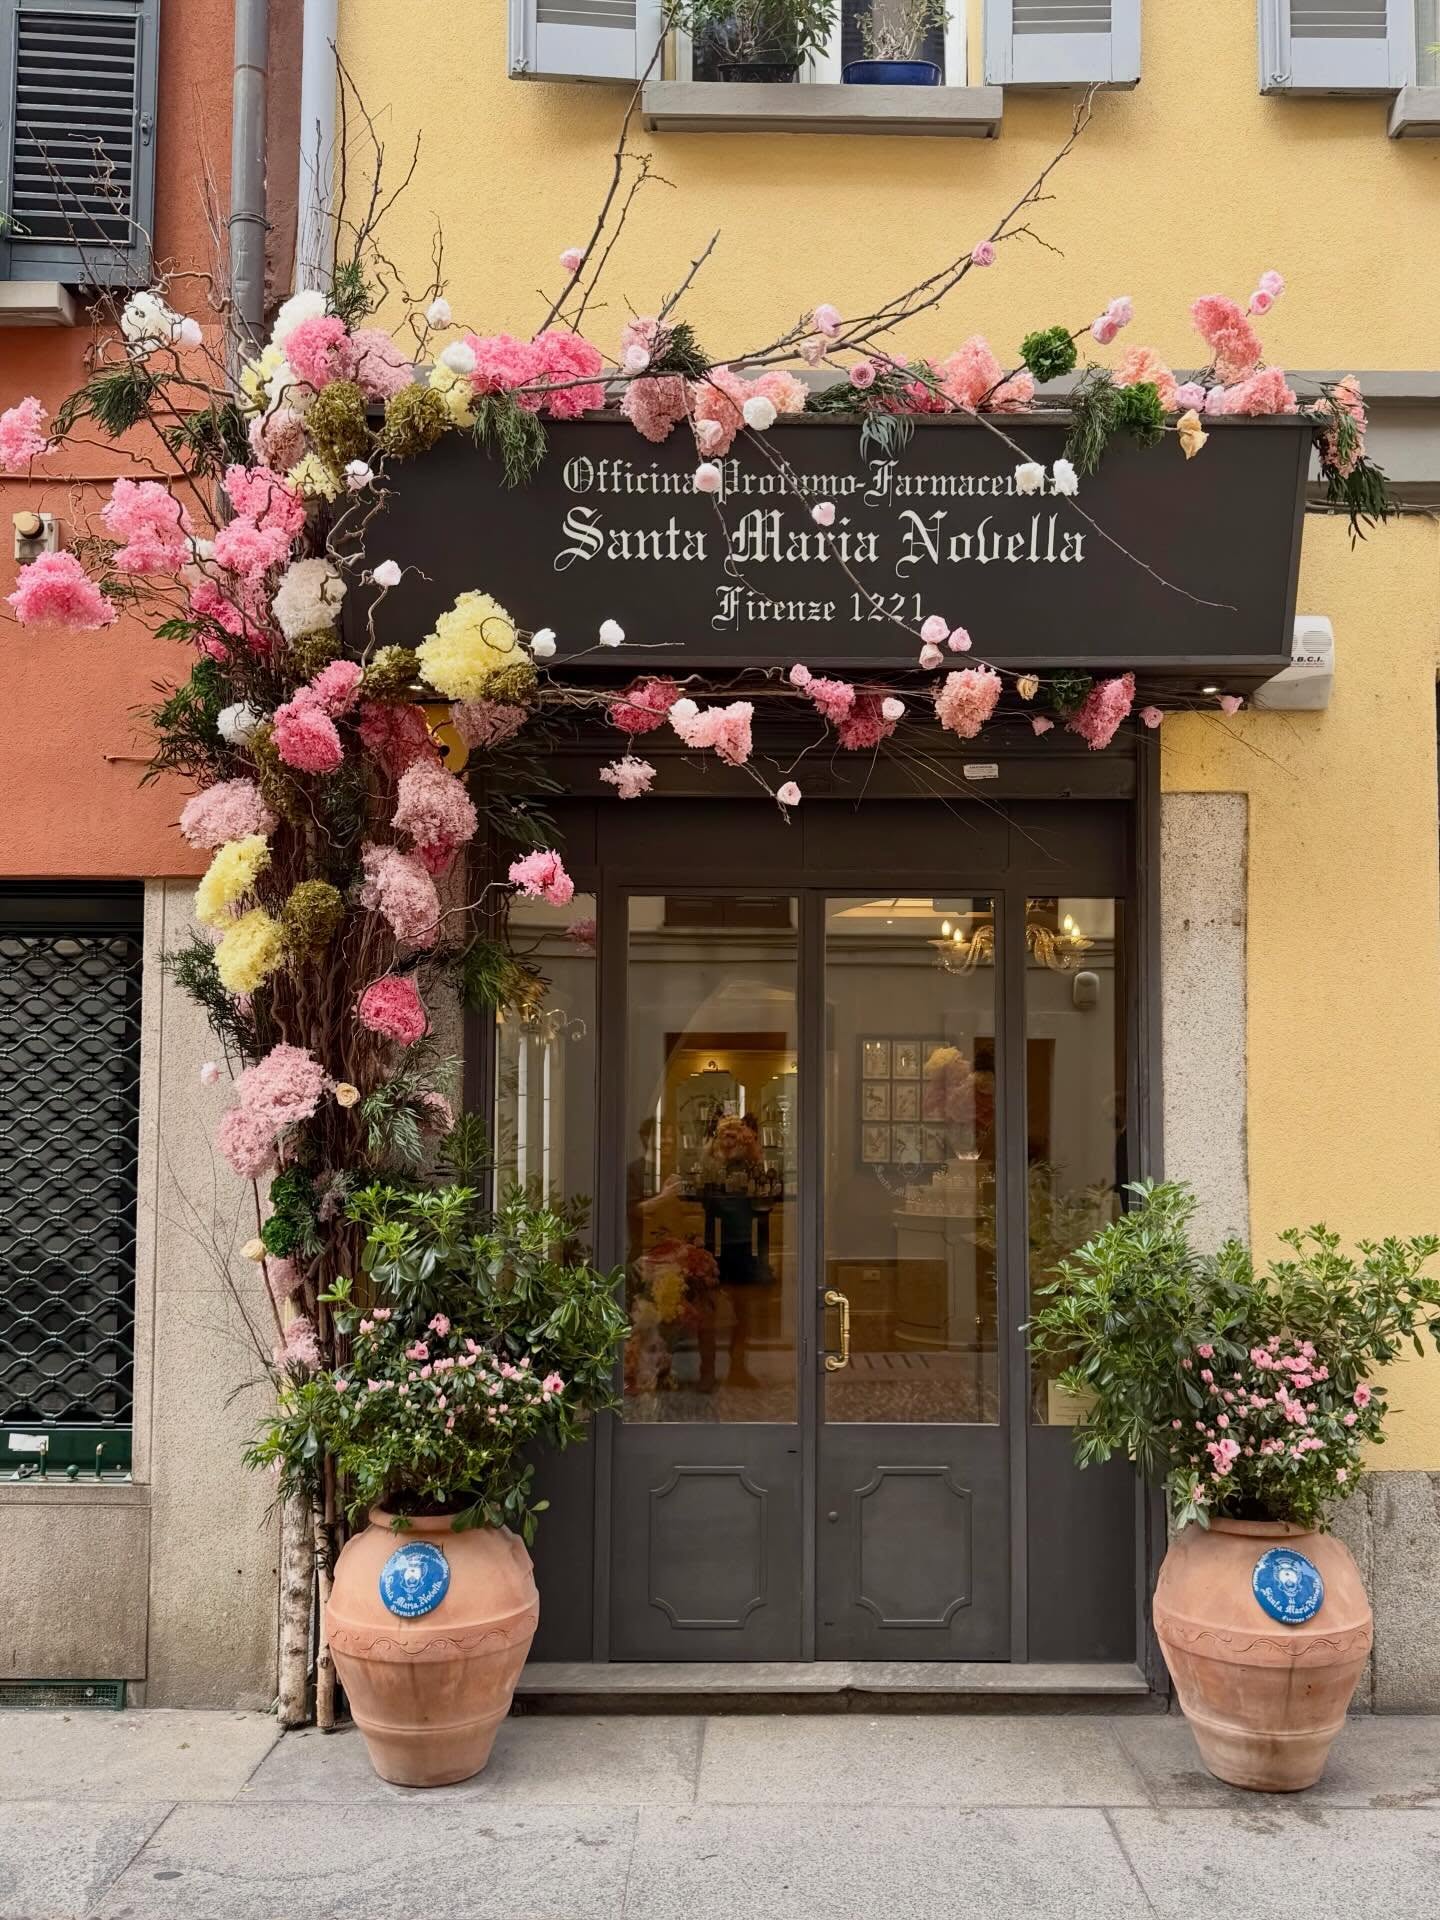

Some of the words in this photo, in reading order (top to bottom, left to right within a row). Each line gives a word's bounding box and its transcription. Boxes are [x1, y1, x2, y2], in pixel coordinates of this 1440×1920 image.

[563, 456, 699, 494] Officina
[553, 505, 709, 571] Santa
[723, 508, 880, 577] Maria
[895, 510, 1087, 578] Novella
[711, 585, 837, 631] Firenze
[849, 593, 927, 622] 1221
